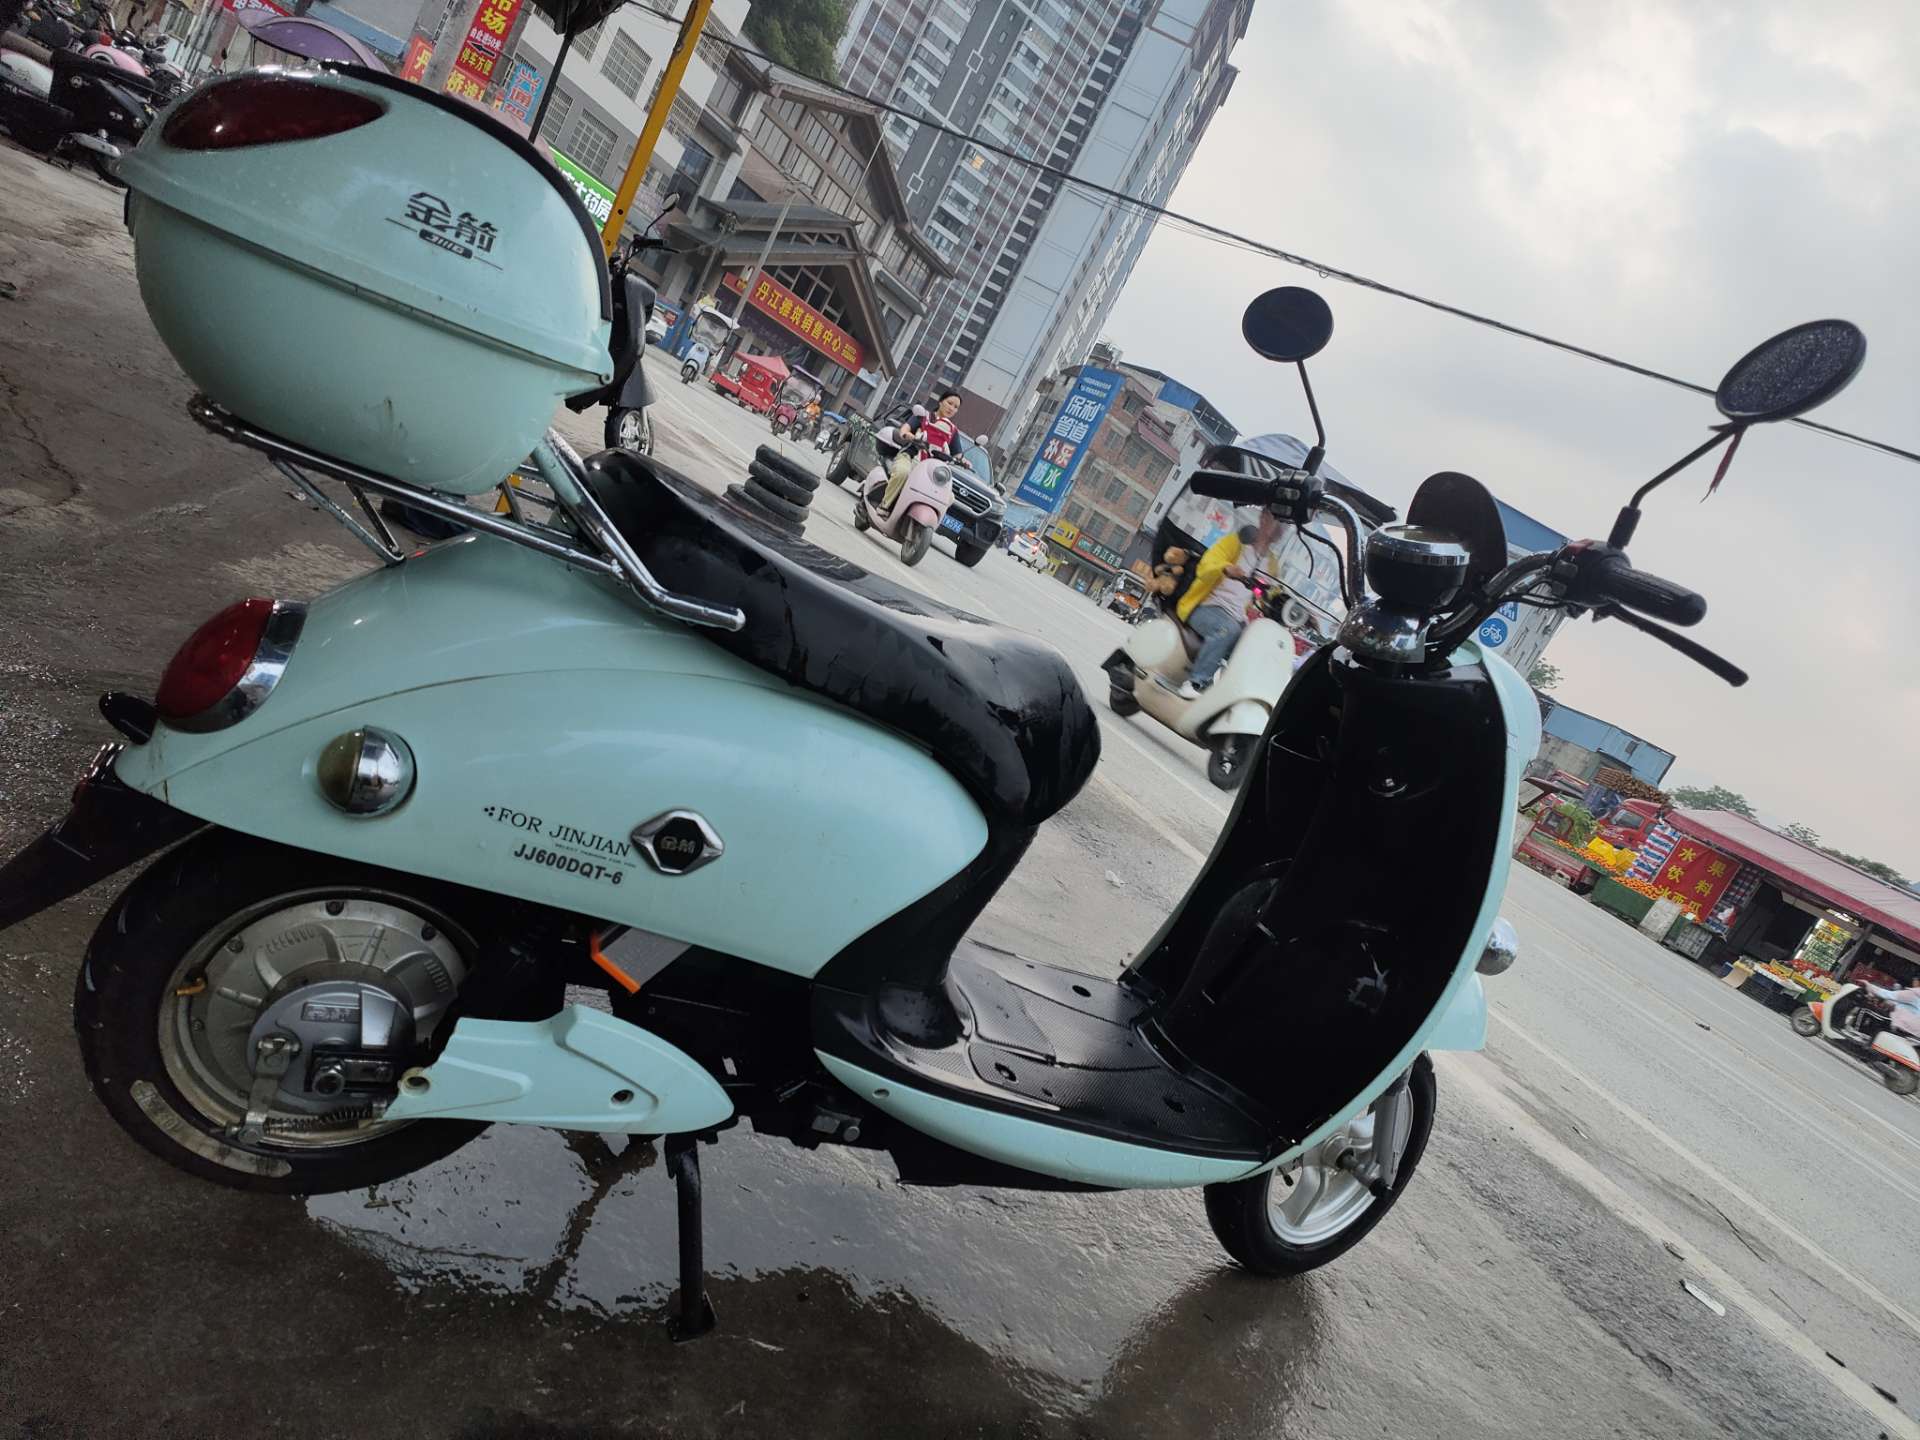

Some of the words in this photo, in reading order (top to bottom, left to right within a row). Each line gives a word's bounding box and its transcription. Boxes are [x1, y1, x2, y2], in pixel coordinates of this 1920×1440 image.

[1064, 394, 1101, 423] 保利
[1053, 415, 1089, 444] 管道
[498, 807, 543, 833] FOR
[549, 823, 631, 858] JINJIAN
[513, 843, 624, 885] JJ600DQT-6
[1678, 847, 1728, 879] 水果
[1666, 864, 1714, 897] 饮料
